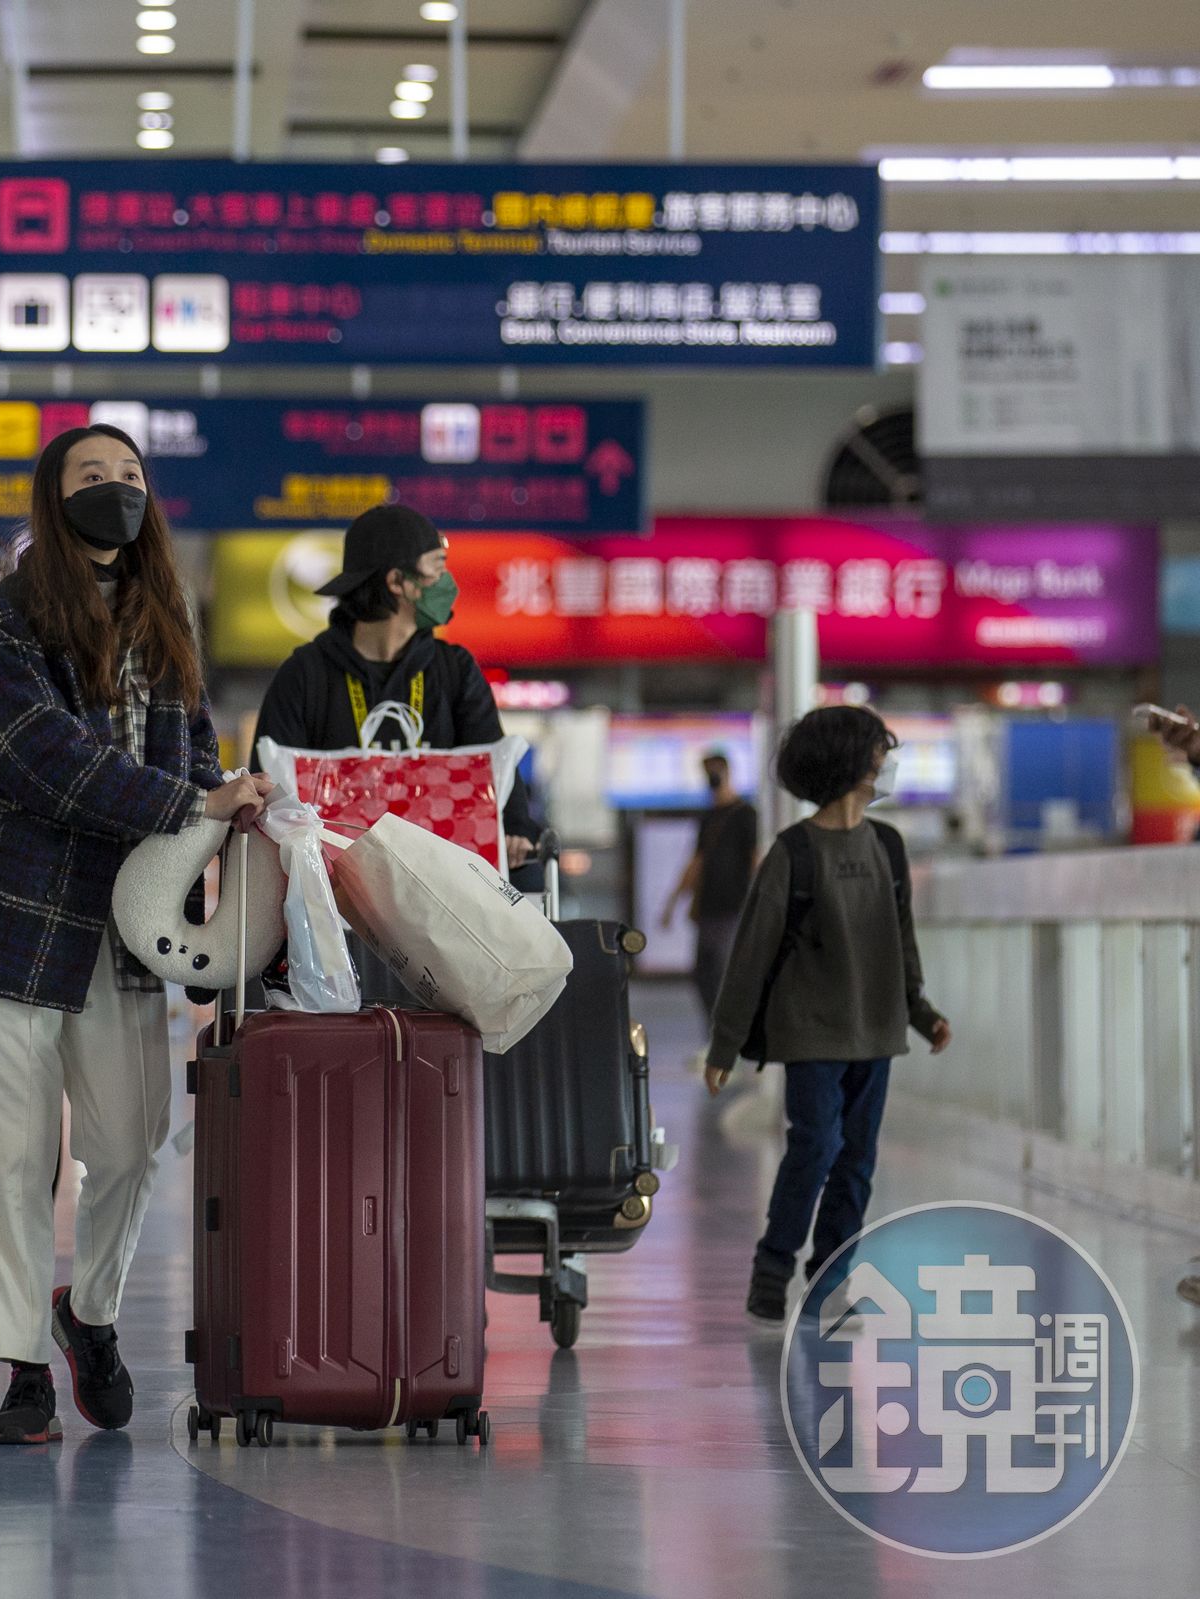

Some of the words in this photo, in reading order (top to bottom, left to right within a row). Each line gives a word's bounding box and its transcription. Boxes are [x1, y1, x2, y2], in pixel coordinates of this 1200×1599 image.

[498, 555, 945, 618] 兆豐國際商業銀行
[955, 559, 1031, 604] Mega
[1034, 559, 1104, 598] Bank
